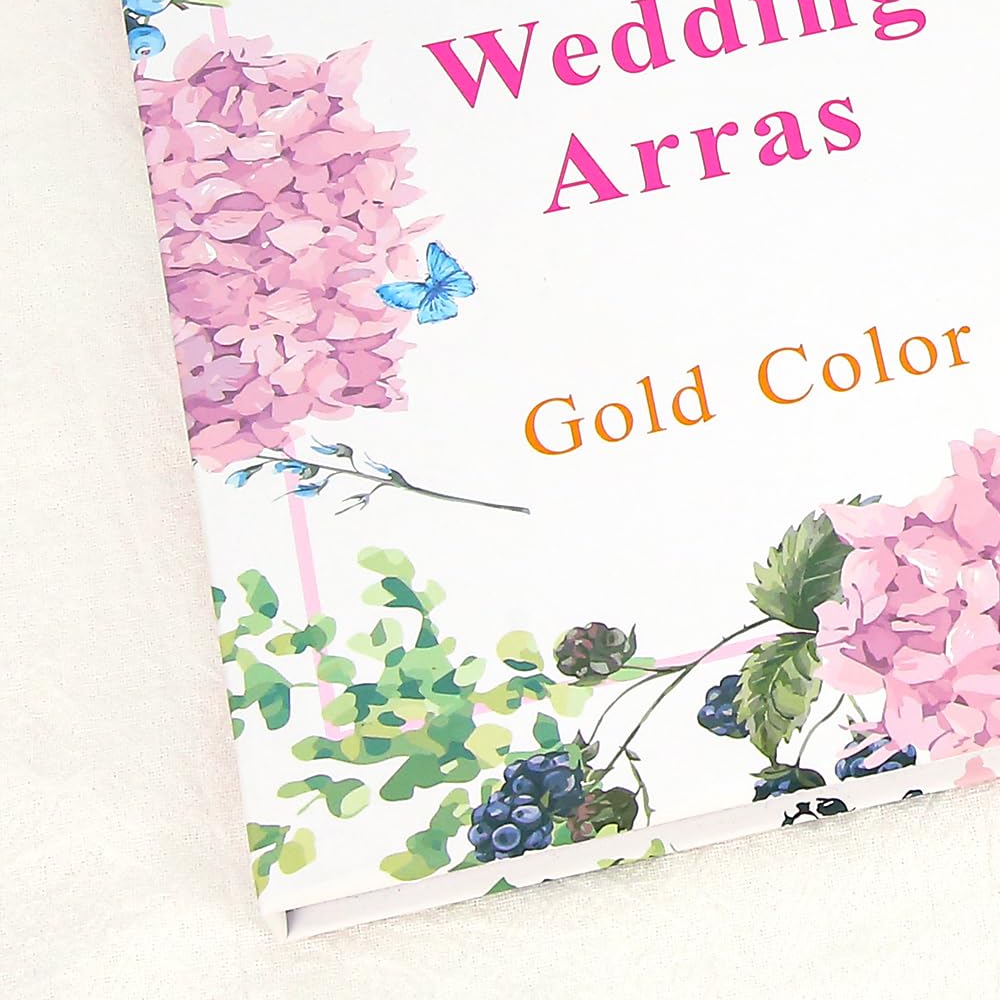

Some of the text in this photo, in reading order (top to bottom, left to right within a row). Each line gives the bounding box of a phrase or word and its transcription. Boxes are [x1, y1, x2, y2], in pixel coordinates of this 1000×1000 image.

[543, 96, 862, 214] Arras
[524, 325, 971, 456] Gold Color
